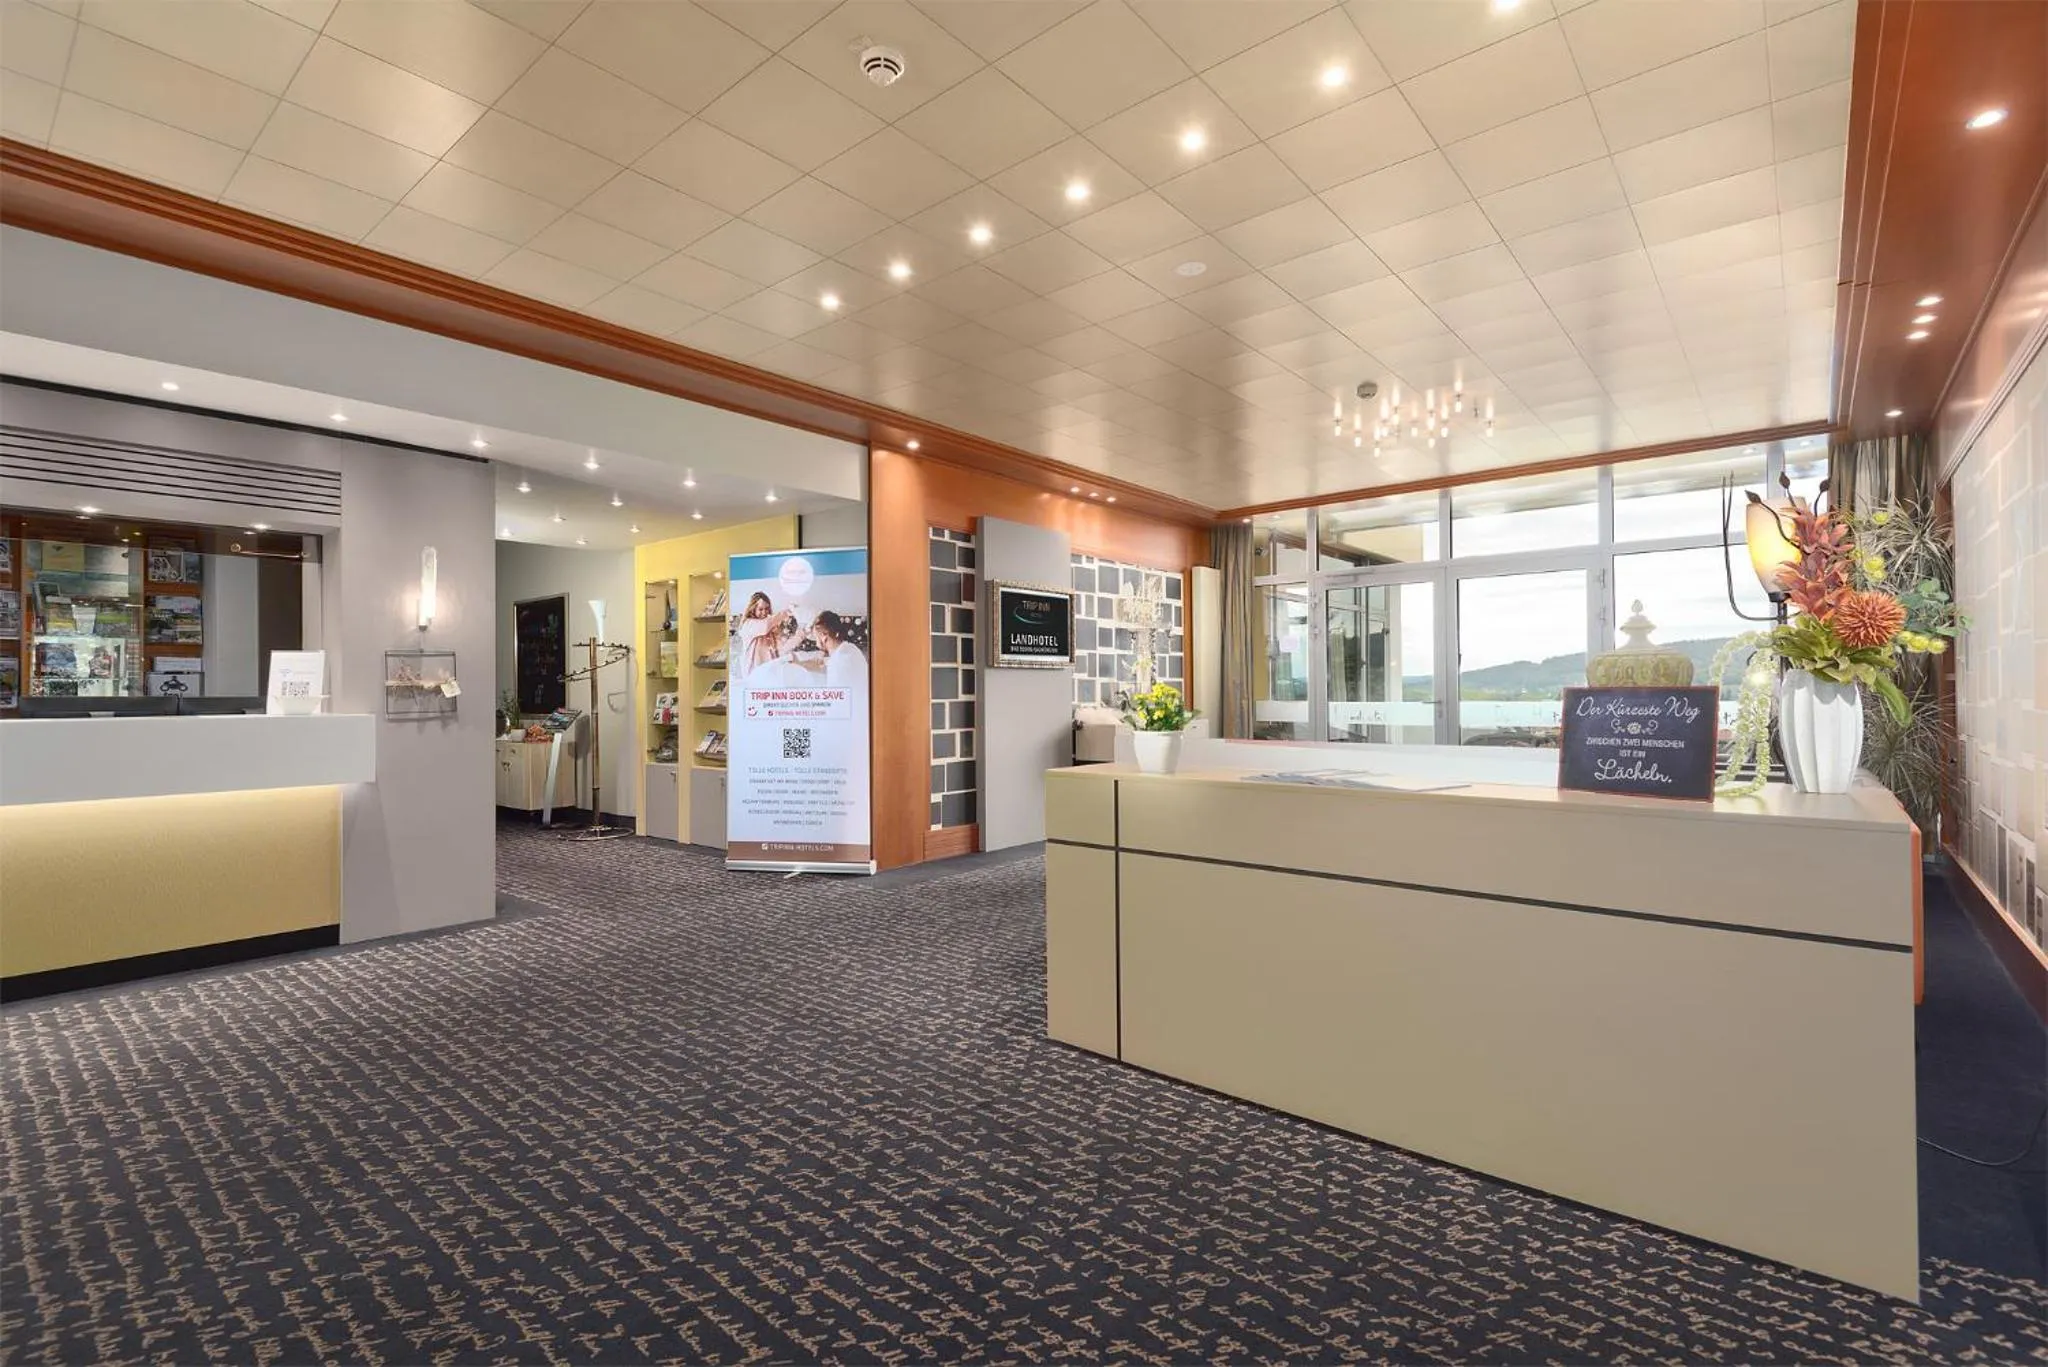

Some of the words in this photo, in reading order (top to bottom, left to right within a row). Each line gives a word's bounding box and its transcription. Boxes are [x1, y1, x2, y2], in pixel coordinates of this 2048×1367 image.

[1022, 600, 1037, 610] TRIP
[1038, 602, 1050, 611] INN
[1010, 633, 1059, 647] LANDHOTEL
[750, 691, 771, 700] TRIP
[772, 691, 788, 700] INN
[789, 691, 813, 700] BOOK
[822, 691, 845, 700] SAVE
[1586, 737, 1621, 746] ZWISCHEN
[1622, 738, 1641, 747] ZWEI
[1642, 739, 1685, 748] MENSCHEN
[1620, 749, 1632, 757] IST
[1632, 750, 1646, 758] EIN
[1594, 758, 1673, 783] Lächeln.
